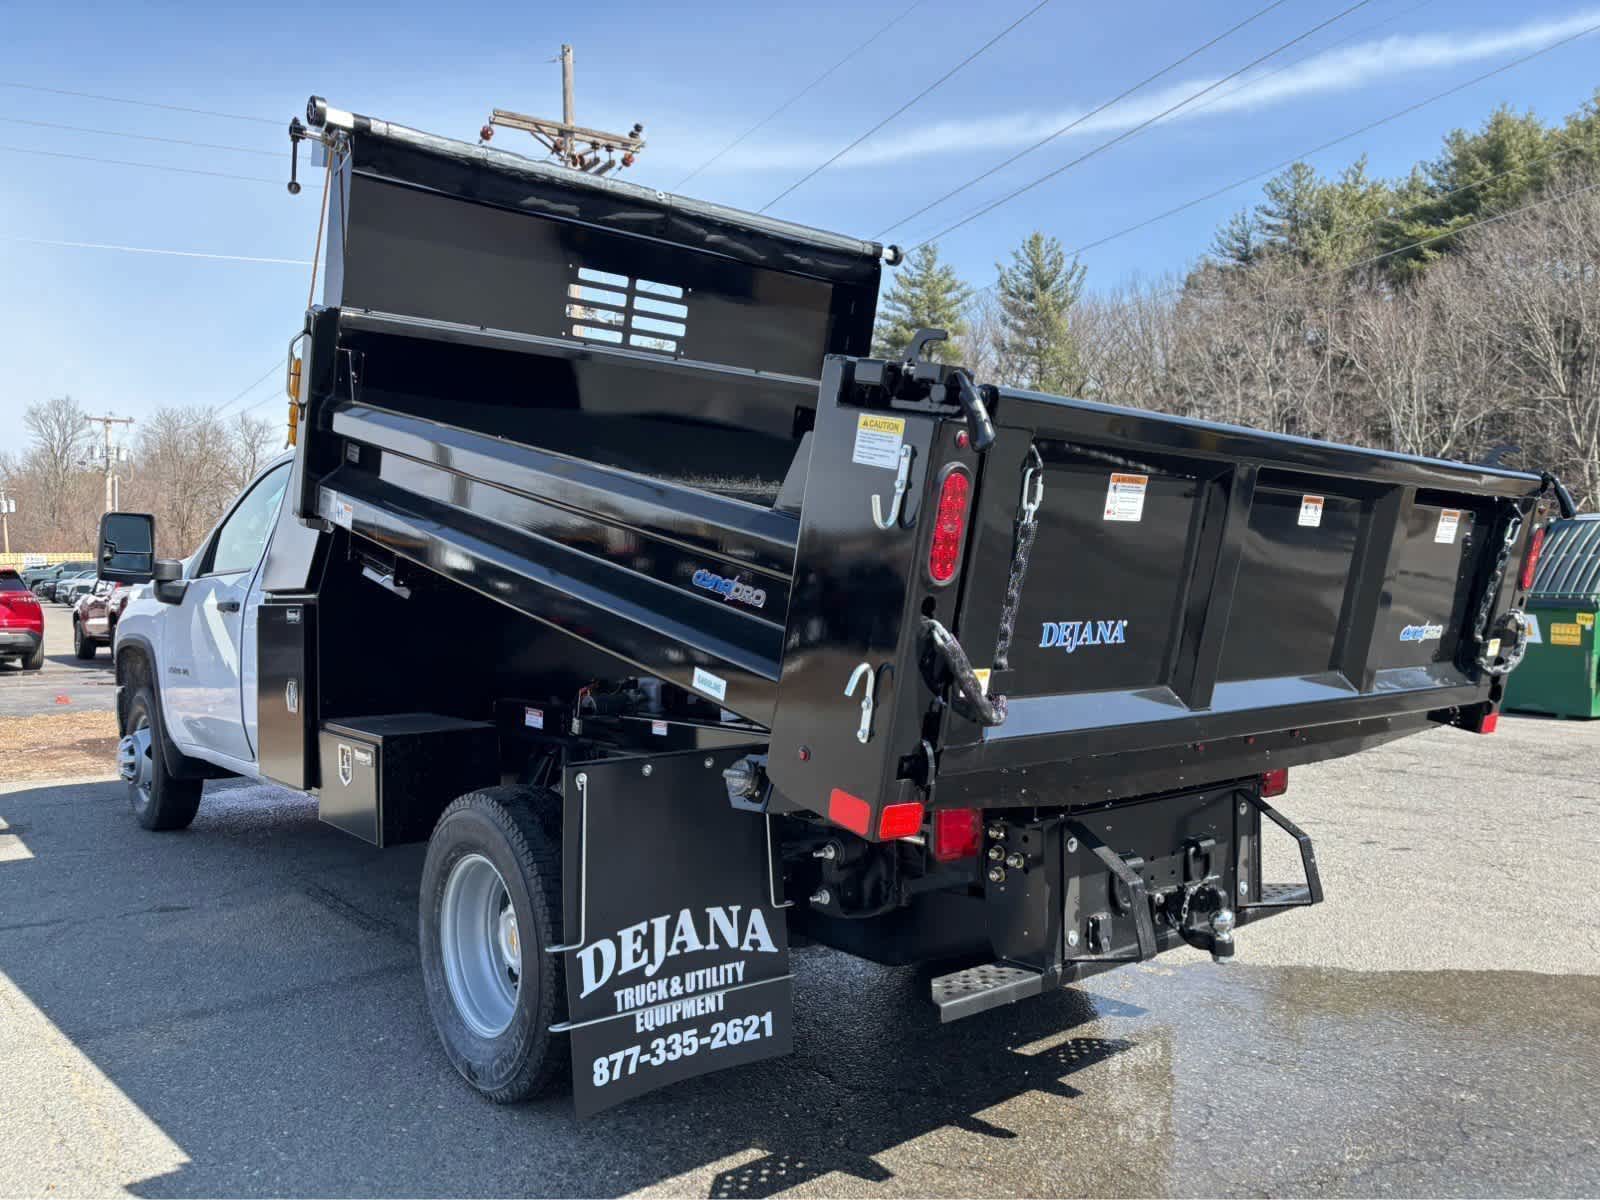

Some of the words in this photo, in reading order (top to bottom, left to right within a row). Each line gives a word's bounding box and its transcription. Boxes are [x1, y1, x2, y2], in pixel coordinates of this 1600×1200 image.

[869, 419, 901, 432] CAUTION
[1039, 620, 1126, 653] DEJANA
[576, 905, 778, 999] DEJANA
[635, 991, 726, 1033] EQUIPMENT
[592, 1011, 773, 1087] 877-335-2621
